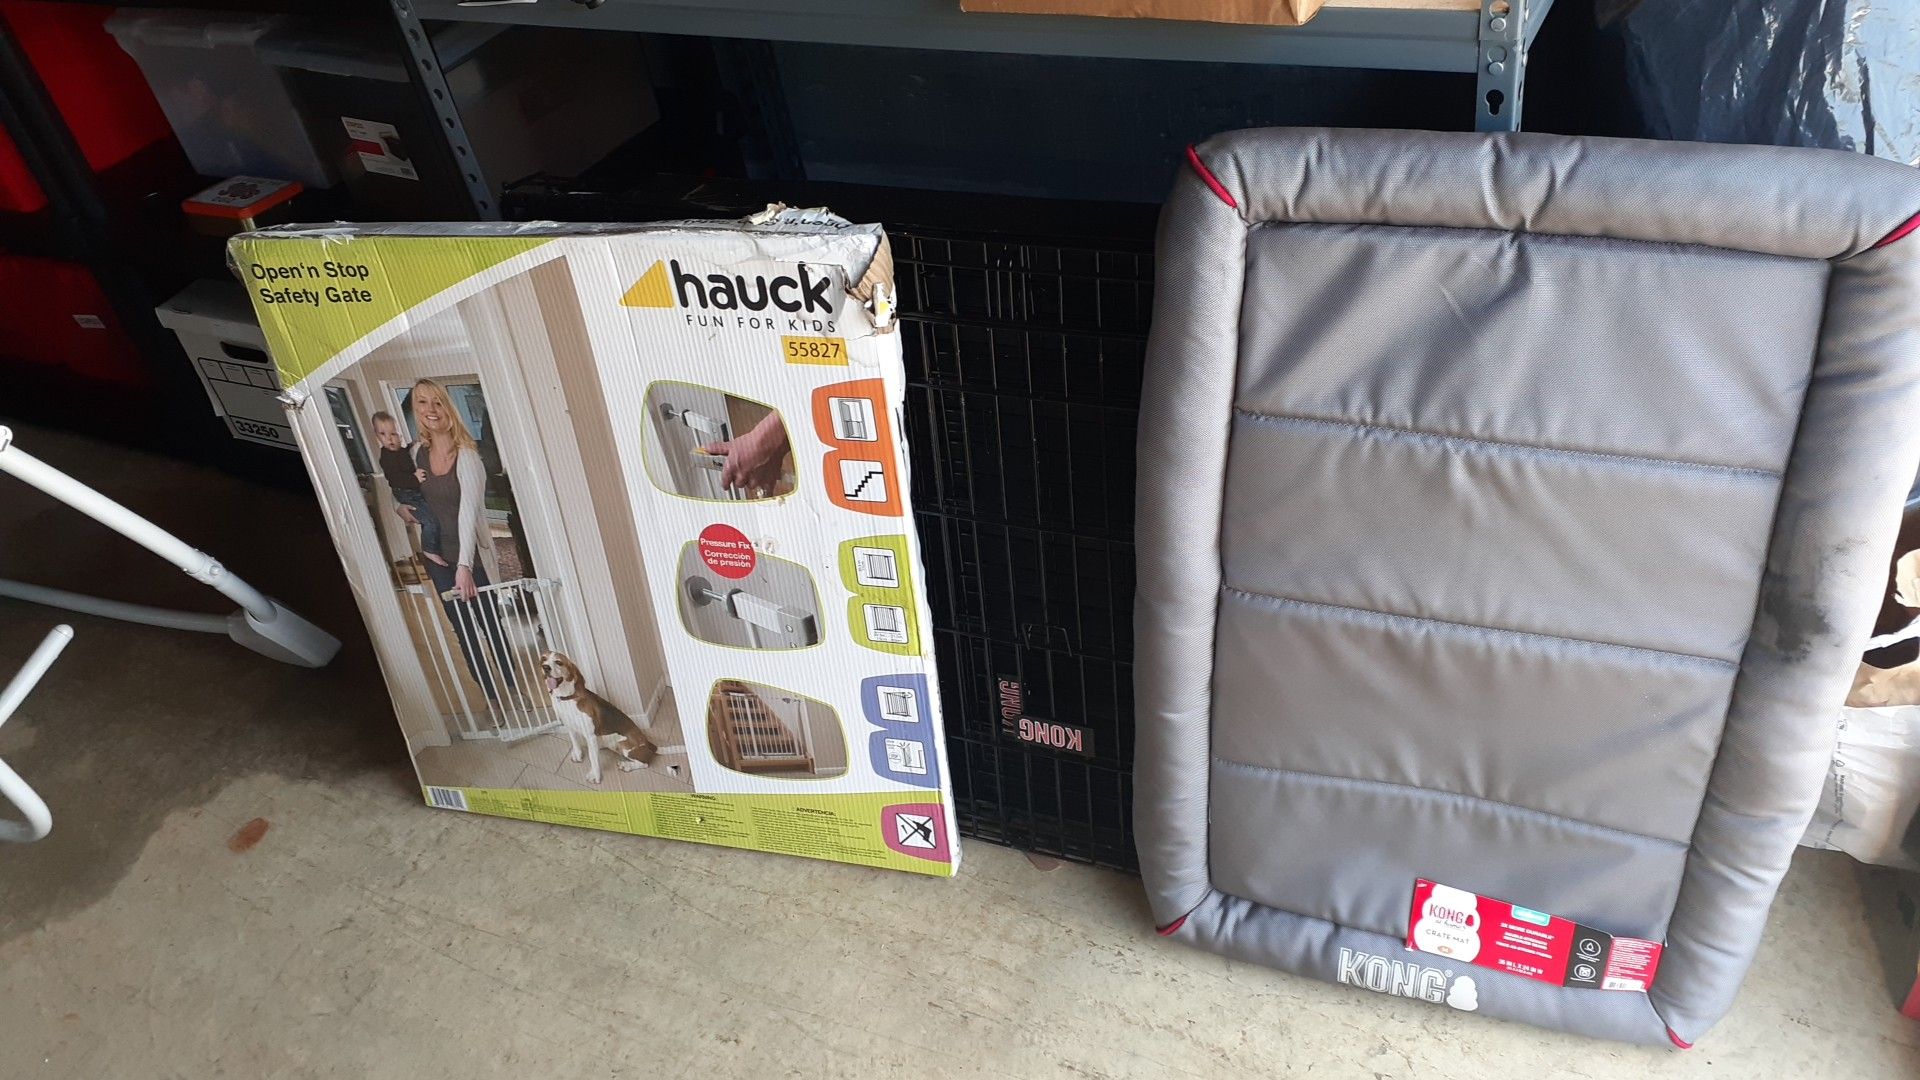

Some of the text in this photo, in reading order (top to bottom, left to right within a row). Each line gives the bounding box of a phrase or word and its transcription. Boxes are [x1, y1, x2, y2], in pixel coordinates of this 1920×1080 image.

[323, 261, 369, 281] Stop
[670, 259, 833, 314] hauck
[260, 286, 373, 307] Safety Gate
[686, 314, 836, 333] FUN FOR KIDS
[788, 341, 841, 358] 55827
[235, 420, 280, 438] 33250
[700, 537, 751, 550] Pressure Fix
[707, 557, 719, 566] de
[1018, 718, 1083, 752] KONG
[1429, 903, 1465, 924] KONG
[1425, 928, 1470, 945] CRATE MAT
[1337, 947, 1447, 1004] KONG
